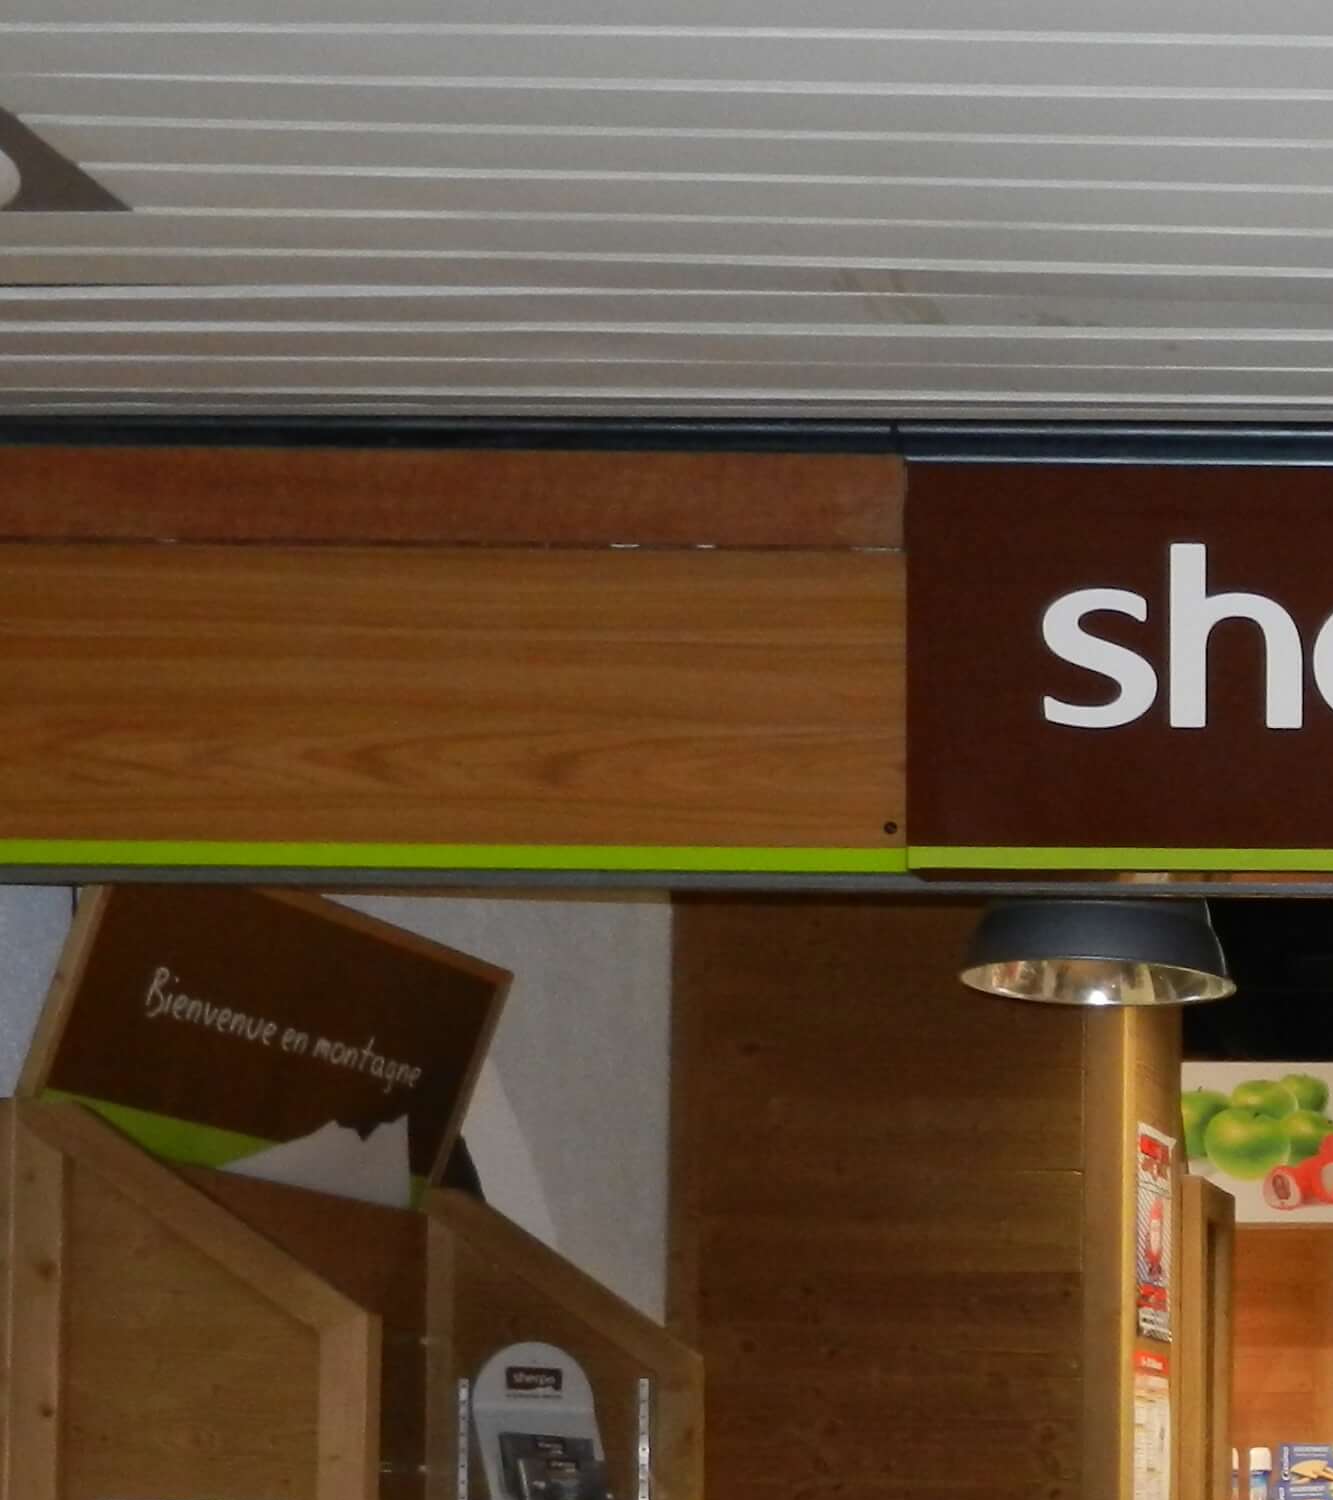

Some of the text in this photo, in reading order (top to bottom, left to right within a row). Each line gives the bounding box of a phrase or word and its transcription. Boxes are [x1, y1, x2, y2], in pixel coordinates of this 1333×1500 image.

[145, 965, 423, 1094] Bienvenue en montagne
